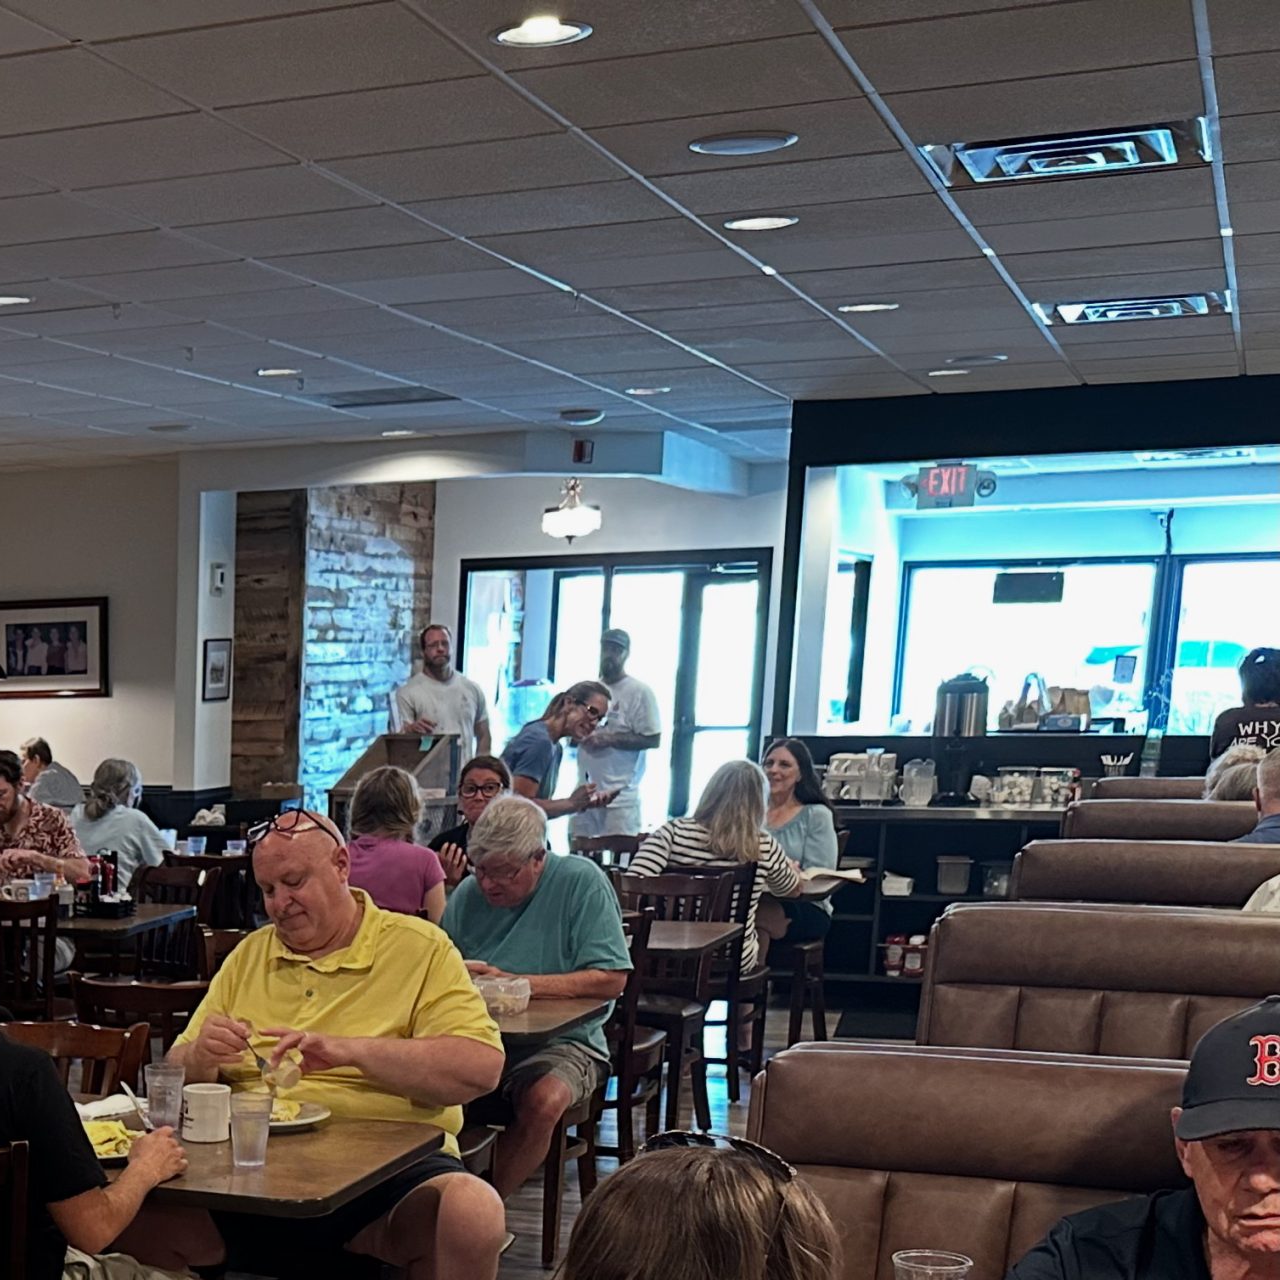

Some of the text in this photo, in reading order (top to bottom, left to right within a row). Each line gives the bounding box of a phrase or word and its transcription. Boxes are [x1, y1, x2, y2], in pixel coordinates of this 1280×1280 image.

[928, 467, 966, 496] EXIT
[1238, 720, 1280, 736] WHY
[1246, 1034, 1280, 1086] B
